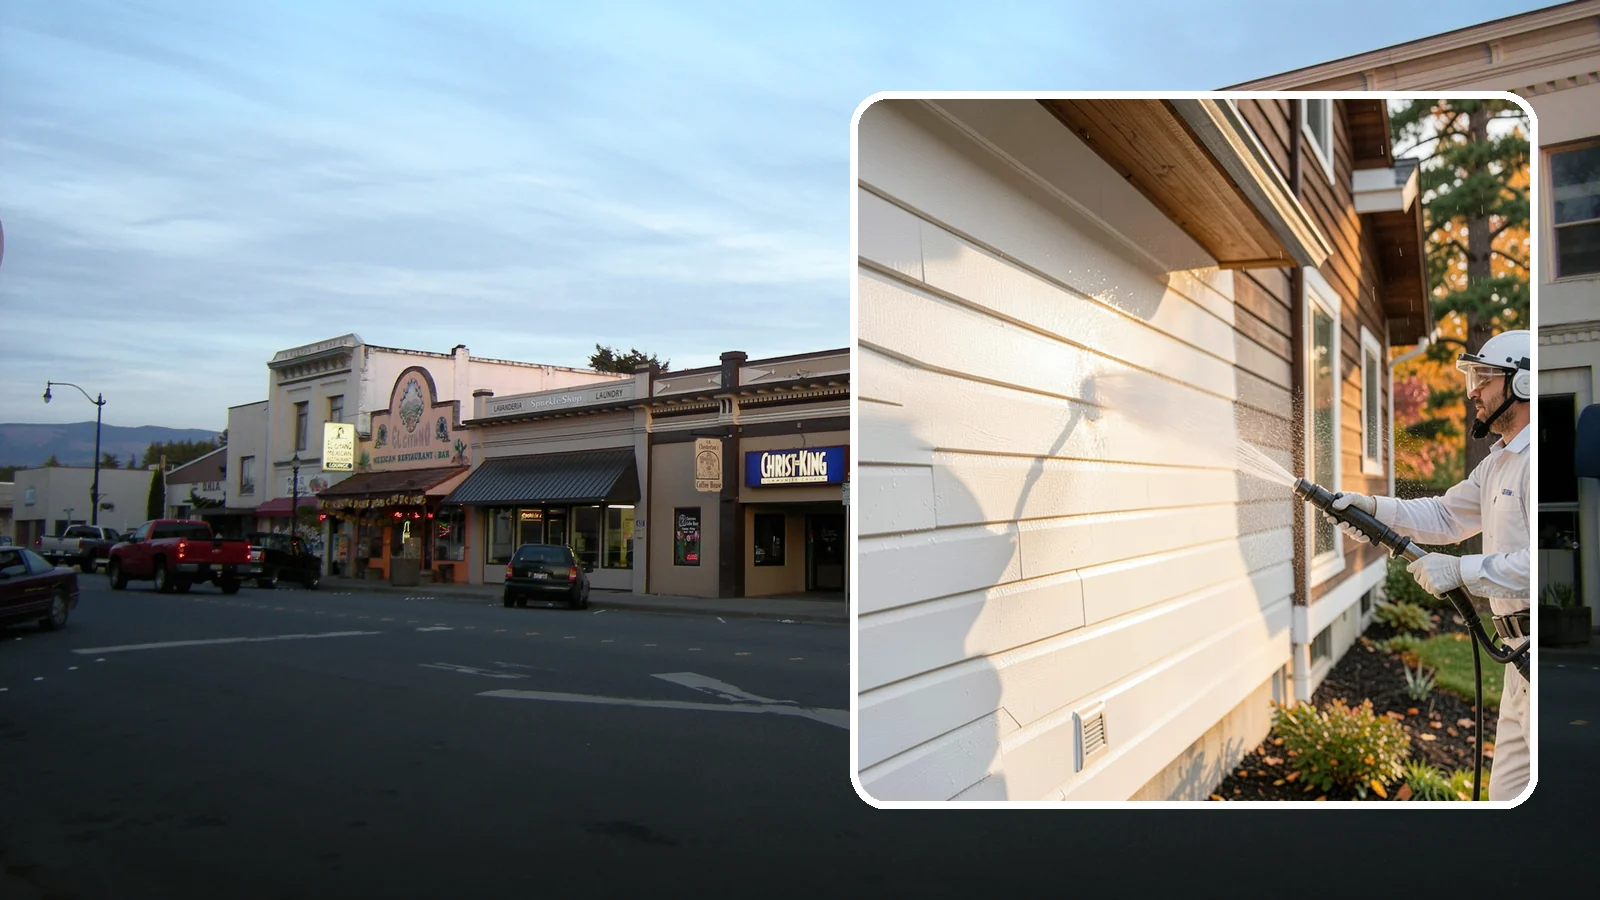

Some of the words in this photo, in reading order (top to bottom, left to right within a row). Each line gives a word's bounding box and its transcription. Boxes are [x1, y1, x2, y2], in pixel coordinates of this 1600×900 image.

[595, 388, 624, 400] LAUNDRY
[493, 402, 522, 413] LAVANDERIA
[530, 397, 561, 409] Sparkle
[561, 394, 582, 407] Shop
[373, 454, 396, 464] MEXICAN
[397, 451, 433, 462] RESTAURANT
[437, 449, 450, 459] BAR
[760, 452, 797, 478] CHRIST
[799, 450, 827, 476] KING
[696, 480, 709, 489] Coffee
[709, 480, 722, 489] House
